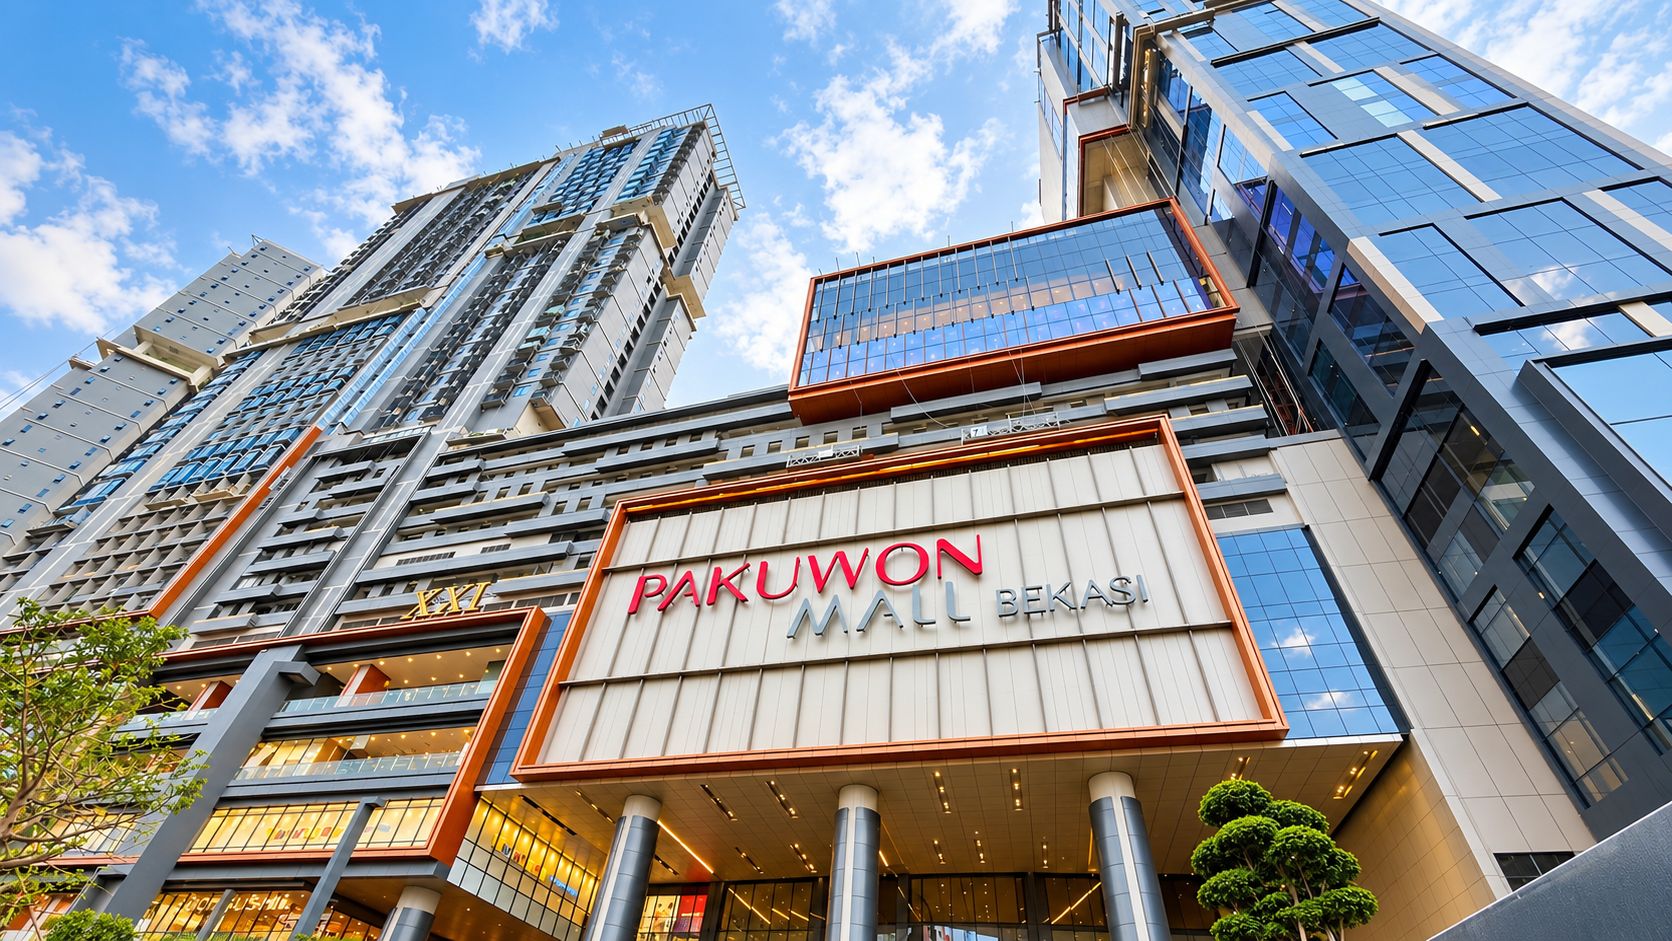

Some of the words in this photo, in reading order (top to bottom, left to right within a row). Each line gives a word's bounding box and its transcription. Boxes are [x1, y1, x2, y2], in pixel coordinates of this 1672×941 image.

[400, 582, 492, 620] XXI
[628, 534, 983, 615] PAKUWON
[787, 581, 971, 639] MALL
[996, 574, 1149, 618] BEKASI
